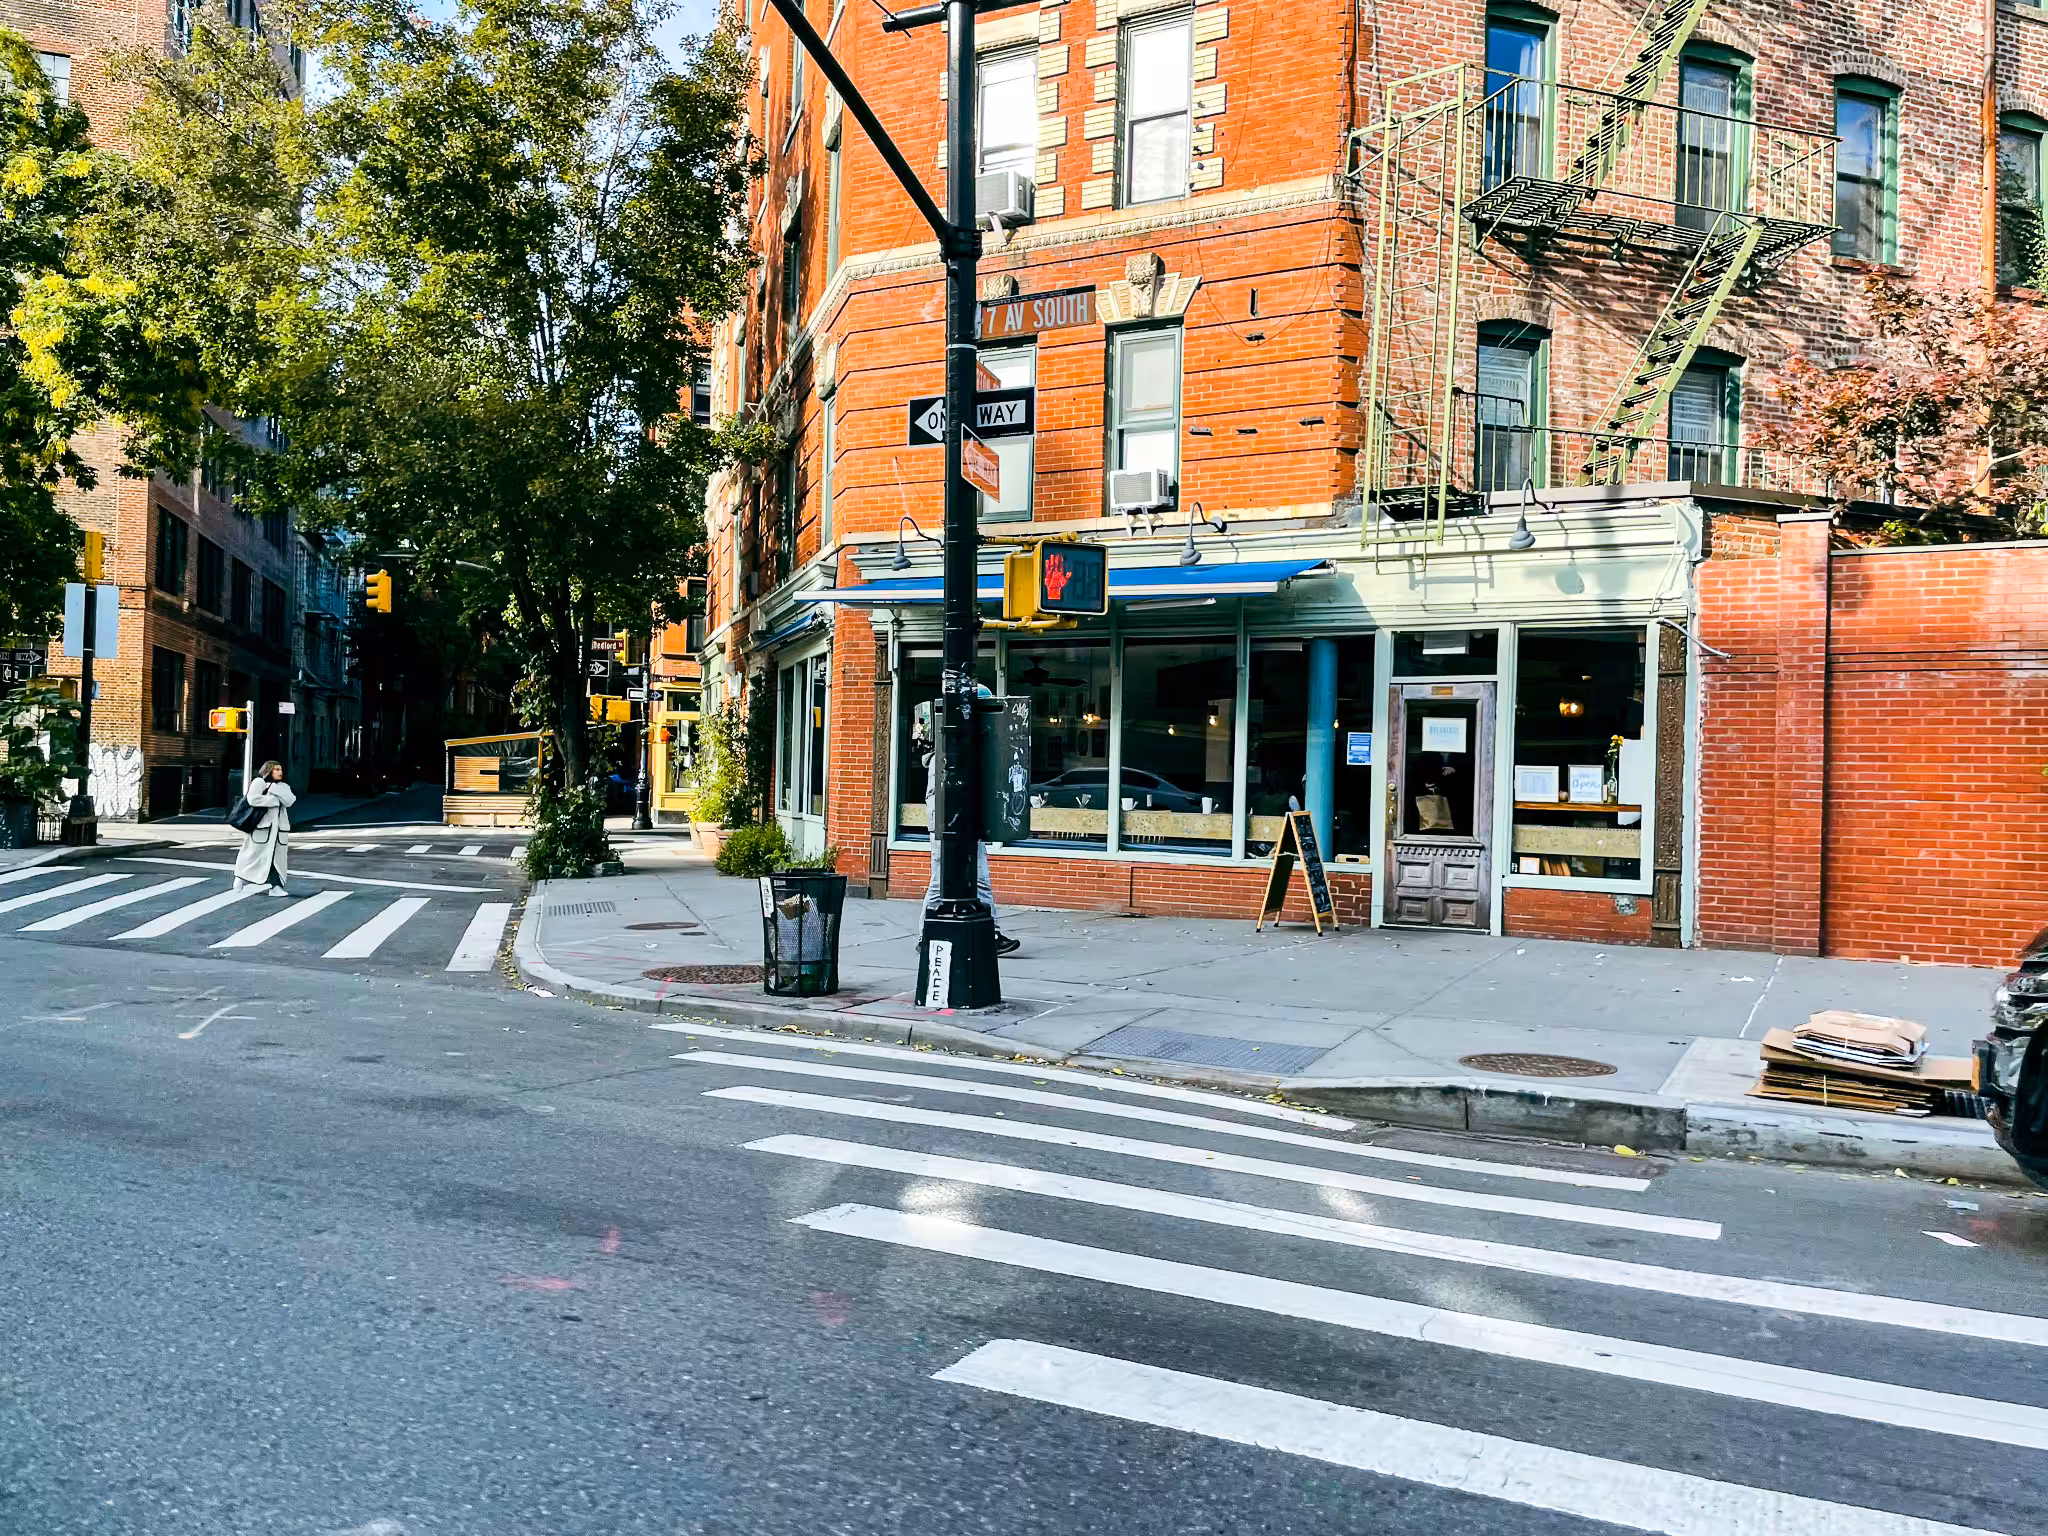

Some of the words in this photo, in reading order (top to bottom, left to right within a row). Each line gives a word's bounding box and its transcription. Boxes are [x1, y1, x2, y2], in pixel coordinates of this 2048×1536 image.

[986, 305, 997, 334] 7
[1004, 303, 1025, 332] AV
[1033, 292, 1089, 329] SOUTH
[979, 403, 1018, 425] WAY
[932, 945, 944, 1001] PEACE
